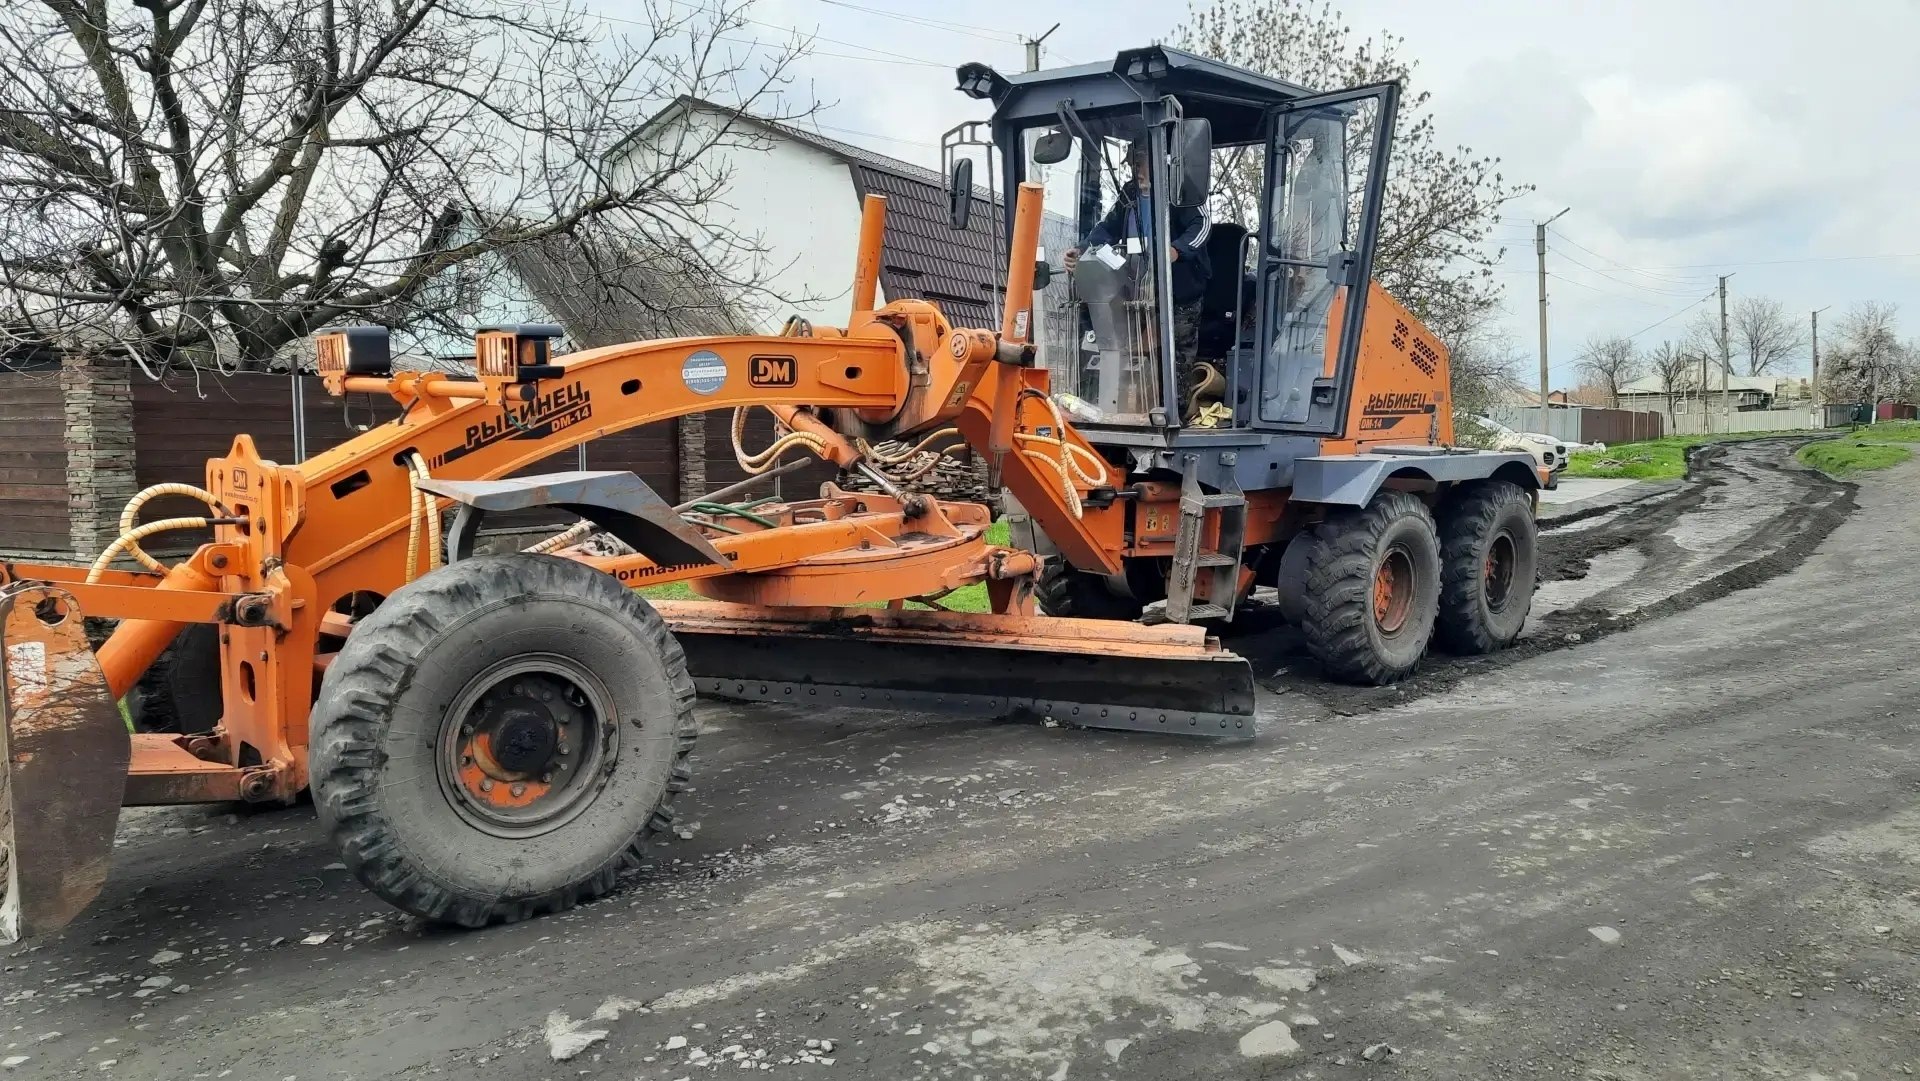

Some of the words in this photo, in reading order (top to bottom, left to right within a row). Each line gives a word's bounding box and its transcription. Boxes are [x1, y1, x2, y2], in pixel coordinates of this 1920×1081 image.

[1368, 392, 1427, 411] РЫБИНЕЦ
[466, 380, 585, 448] РЫБИНЕЦ
[551, 406, 590, 433] DM-14
[1361, 418, 1383, 429] DM-14
